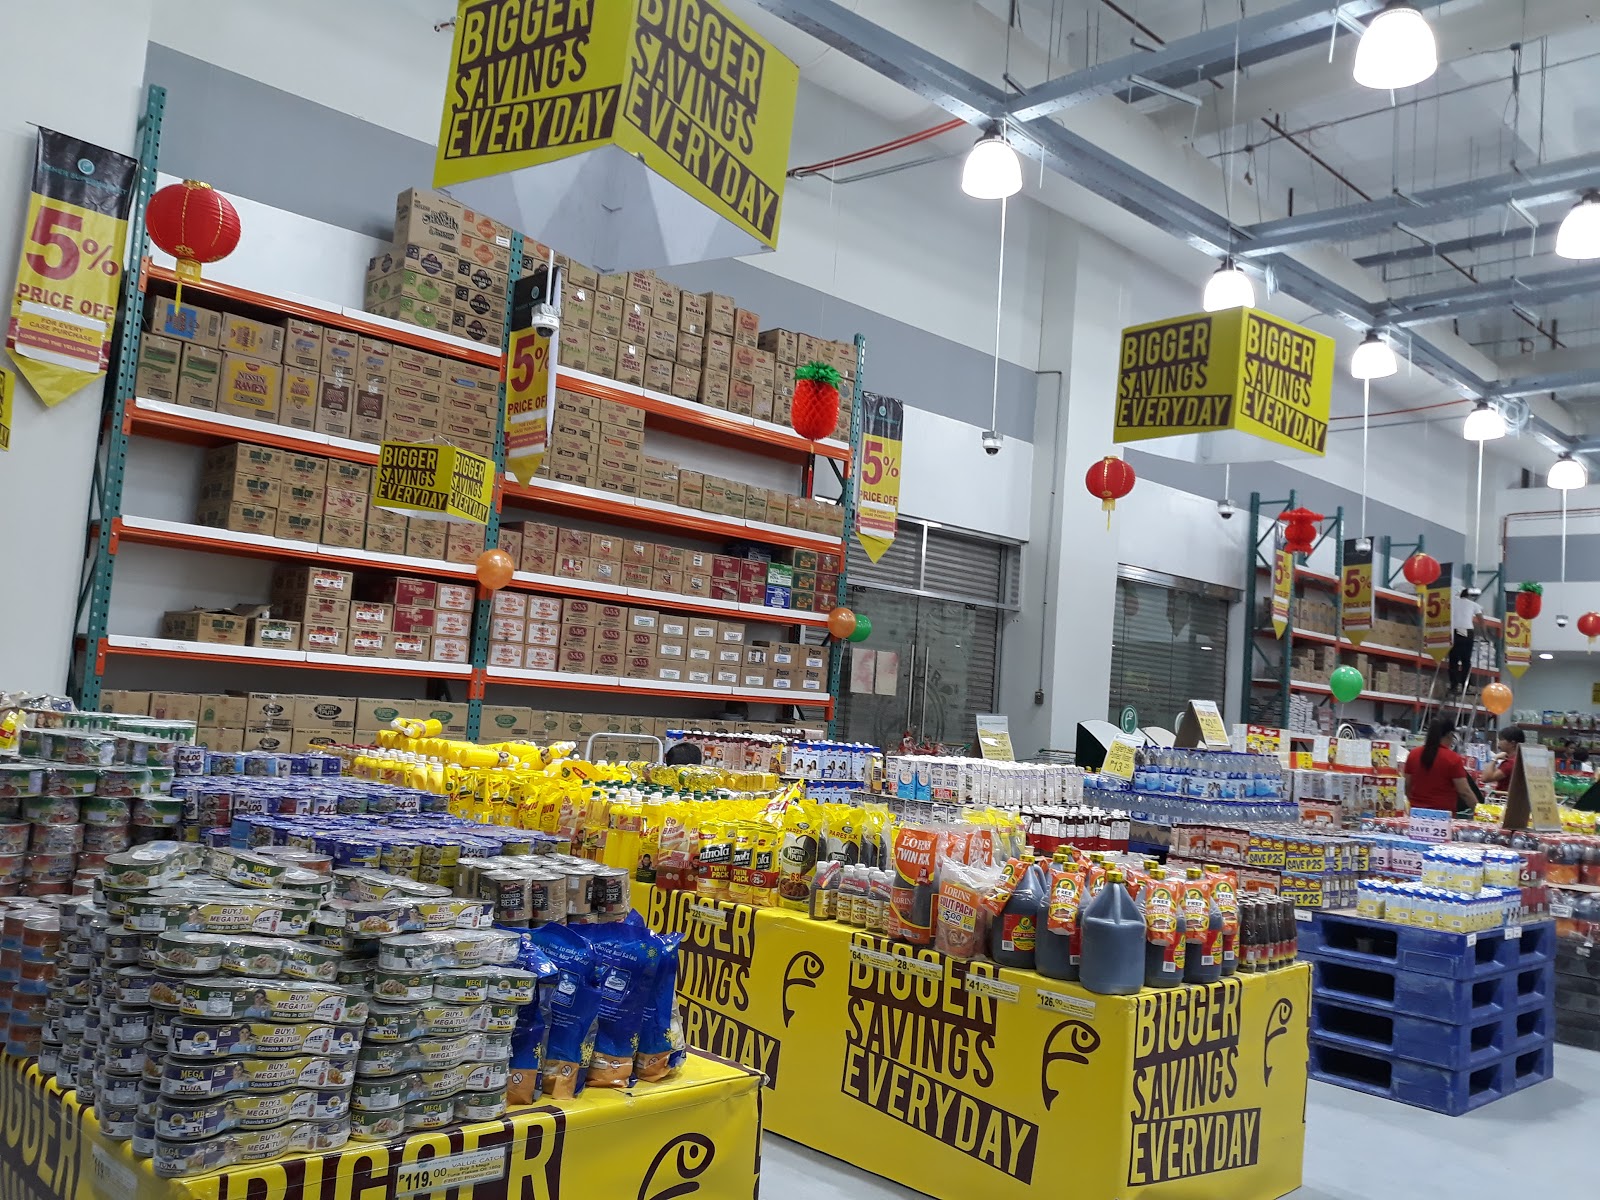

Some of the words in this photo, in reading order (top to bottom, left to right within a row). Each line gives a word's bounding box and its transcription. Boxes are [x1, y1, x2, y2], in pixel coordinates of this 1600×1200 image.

[460, 0, 591, 64] BIGGER
[453, 35, 590, 111] SAVINGS
[630, 25, 757, 155] SAVINGS
[445, 88, 615, 158] EVERYDAY
[625, 76, 773, 232] EVERYDAY
[25, 206, 118, 281] 5%
[18, 283, 74, 311] PRICE
[80, 300, 114, 320] OFF
[41, 318, 56, 326] FOR
[60, 322, 84, 332] EVERY
[29, 322, 50, 332] CASE
[52, 328, 93, 343] PURCHASE
[1123, 322, 1210, 370] BIGGER
[1246, 317, 1314, 377] BIGGER
[238, 371, 265, 384] NISSIN
[1120, 361, 1208, 398] SAVINGS
[1244, 359, 1312, 408] SAVINGS
[234, 379, 267, 396] RAMEN
[507, 399, 534, 415] PRICE
[1117, 396, 1229, 427] EVERYDAY
[1242, 387, 1326, 451] EVERYDAY
[382, 446, 437, 470] BIGGER
[861, 440, 899, 486] 5%
[454, 453, 485, 479] BIGGER
[379, 468, 435, 487] SAVINGS
[450, 475, 483, 499] SAVINGS
[377, 482, 449, 509] EVERYDAY
[860, 489, 882, 503] PRICE
[883, 495, 898, 505] OFF
[449, 490, 488, 521] EVERYDAY
[659, 554, 680, 563] Master
[626, 573, 648, 581] Master
[1344, 569, 1371, 598] 5%
[408, 585, 425, 595] Ligo
[829, 830, 848, 840] PARES
[897, 847, 917, 864] TWIN
[1249, 854, 1266, 864] SAVE
[710, 865, 728, 873] TWIN
[1287, 861, 1305, 870] SAVE
[1393, 858, 1413, 867] SAVE
[252, 864, 271, 876] MEGA
[250, 876, 268, 884] TUNA
[733, 875, 749, 883] PACK
[944, 884, 972, 903] LORINS
[1056, 889, 1072, 897] FREE
[501, 899, 520, 907] BEEF
[939, 896, 955, 910] SULIT
[955, 901, 974, 917] PACK
[233, 915, 250, 923] TUNA
[255, 916, 271, 924] FREE
[648, 884, 751, 958] BIGGER
[324, 928, 342, 937] MEGA
[225, 958, 241, 966] TUNA
[293, 953, 312, 964] MEGA
[622, 953, 637, 962] Salad
[290, 964, 308, 973] TUNA
[466, 979, 482, 987] MEGA
[676, 948, 750, 1012] VINGS
[850, 933, 994, 1025] BIGGER
[182, 1001, 198, 1010] TUNA
[277, 1002, 299, 1010] MEGA
[316, 1003, 335, 1011] FREE
[1136, 982, 1240, 1060] BIGGER
[305, 1035, 324, 1043] FREE
[845, 996, 996, 1088] SAVINGS
[180, 1069, 205, 1080] MEGA
[254, 1071, 277, 1079] MEGA
[278, 1069, 296, 1077] TUNA
[300, 1068, 319, 1077] FREE
[468, 1073, 484, 1081] FREE
[1130, 1045, 1240, 1124] SAVINGS
[259, 1100, 276, 1108] BUY
[423, 1104, 442, 1113] MEGA
[246, 1109, 268, 1117] MEGA
[843, 1047, 1033, 1176] EVERYDAY
[259, 1133, 276, 1142] BUY
[247, 1143, 270, 1152] MEGA
[1129, 1110, 1258, 1184] EVERYDAY
[158, 1162, 178, 1170] TUNA
[452, 1160, 477, 1168] VALUE
